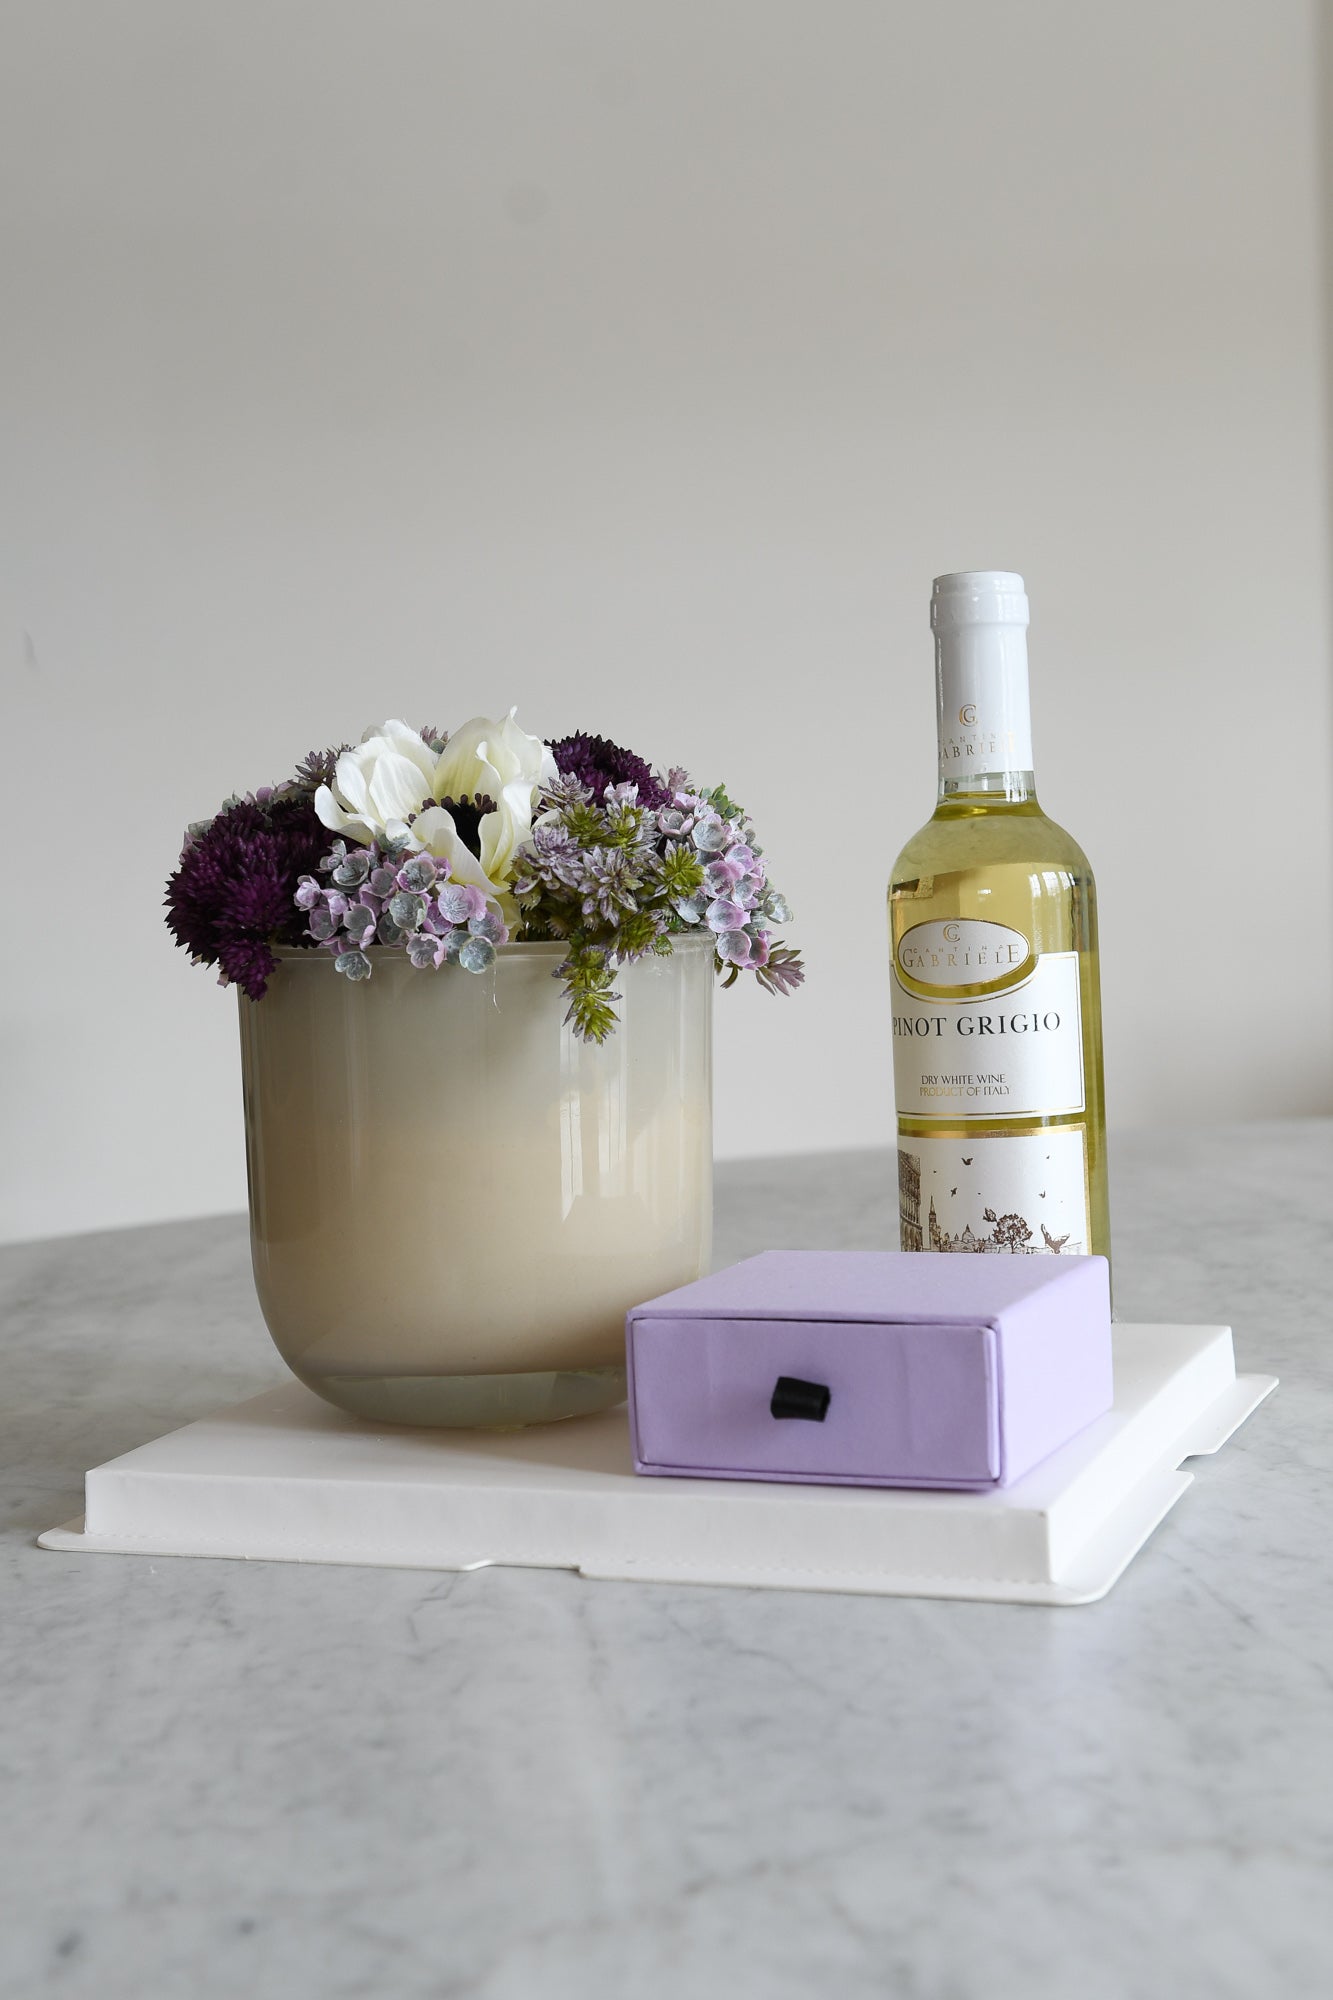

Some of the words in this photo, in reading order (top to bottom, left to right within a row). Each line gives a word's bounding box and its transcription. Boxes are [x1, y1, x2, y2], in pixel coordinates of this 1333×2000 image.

[902, 943, 1021, 968] GABRIELE
[893, 1016, 947, 1037] PINOT
[956, 1011, 1061, 1037] GRIGIO
[921, 1074, 939, 1085] DRY
[941, 1074, 974, 1085] WHITE
[976, 1073, 1006, 1084] WINE
[919, 1086, 964, 1097] PRODUCT
[966, 1086, 982, 1097] OF
[983, 1085, 1010, 1096] ITALY
